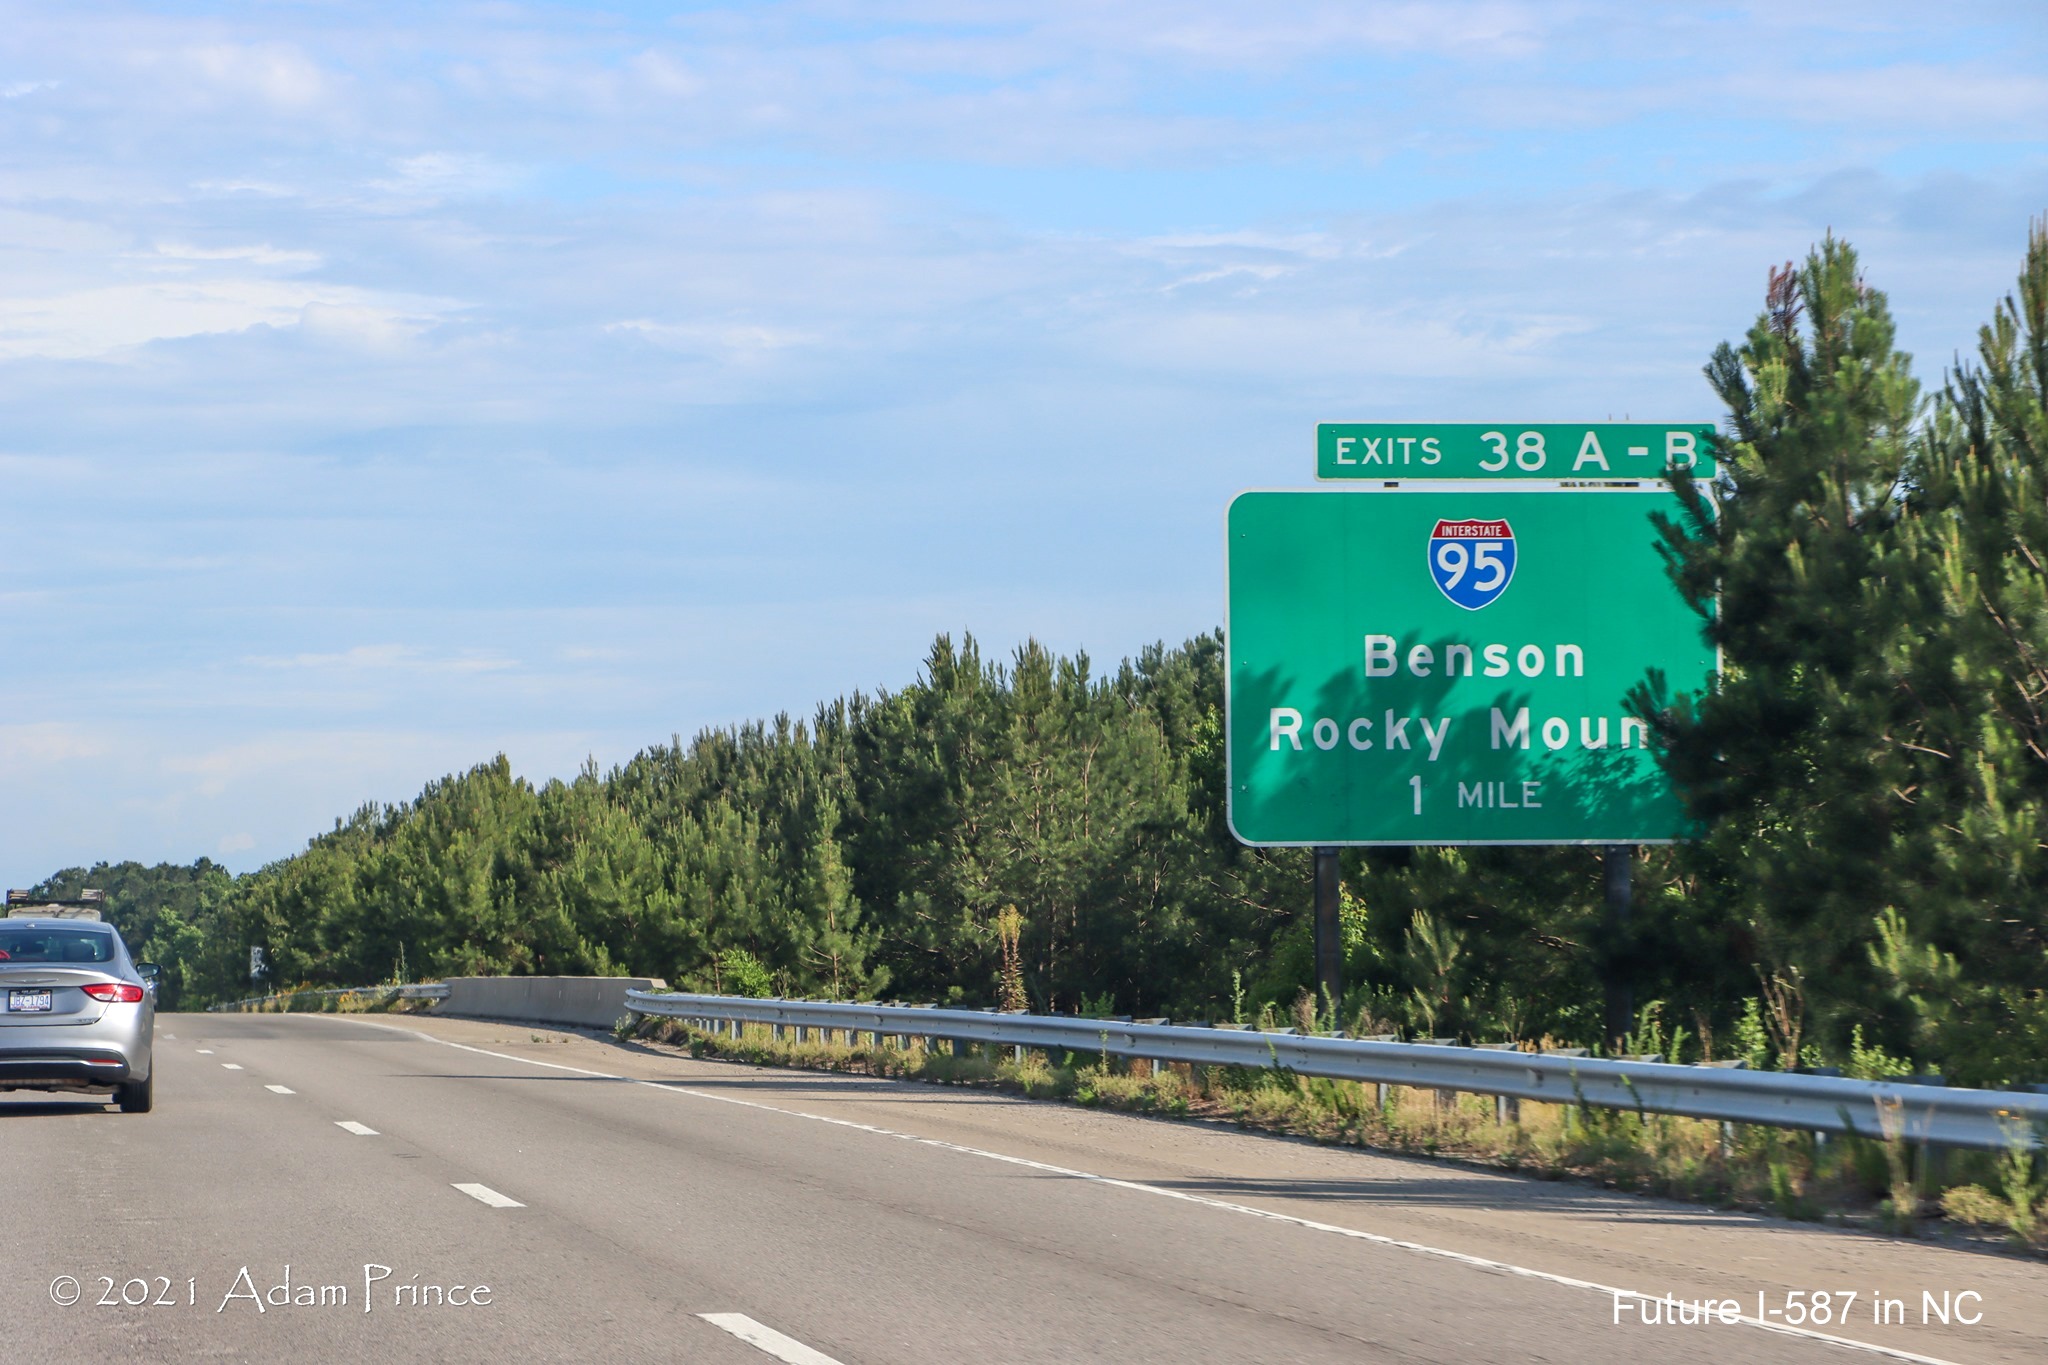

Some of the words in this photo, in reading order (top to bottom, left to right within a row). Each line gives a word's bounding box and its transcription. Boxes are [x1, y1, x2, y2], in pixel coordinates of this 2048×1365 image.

[1335, 436, 1442, 466] EXITS
[1478, 431, 1547, 472] 38
[1572, 431, 1610, 471] A
[1665, 431, 1698, 471] B
[1441, 525, 1503, 537] INTERSTATE
[1437, 542, 1506, 592] 95
[1364, 634, 1585, 678] Benson
[1269, 707, 1451, 761] Rocky
[1490, 707, 1668, 751] Moun
[1409, 775, 1422, 815] 1
[1457, 781, 1542, 808] MILE
